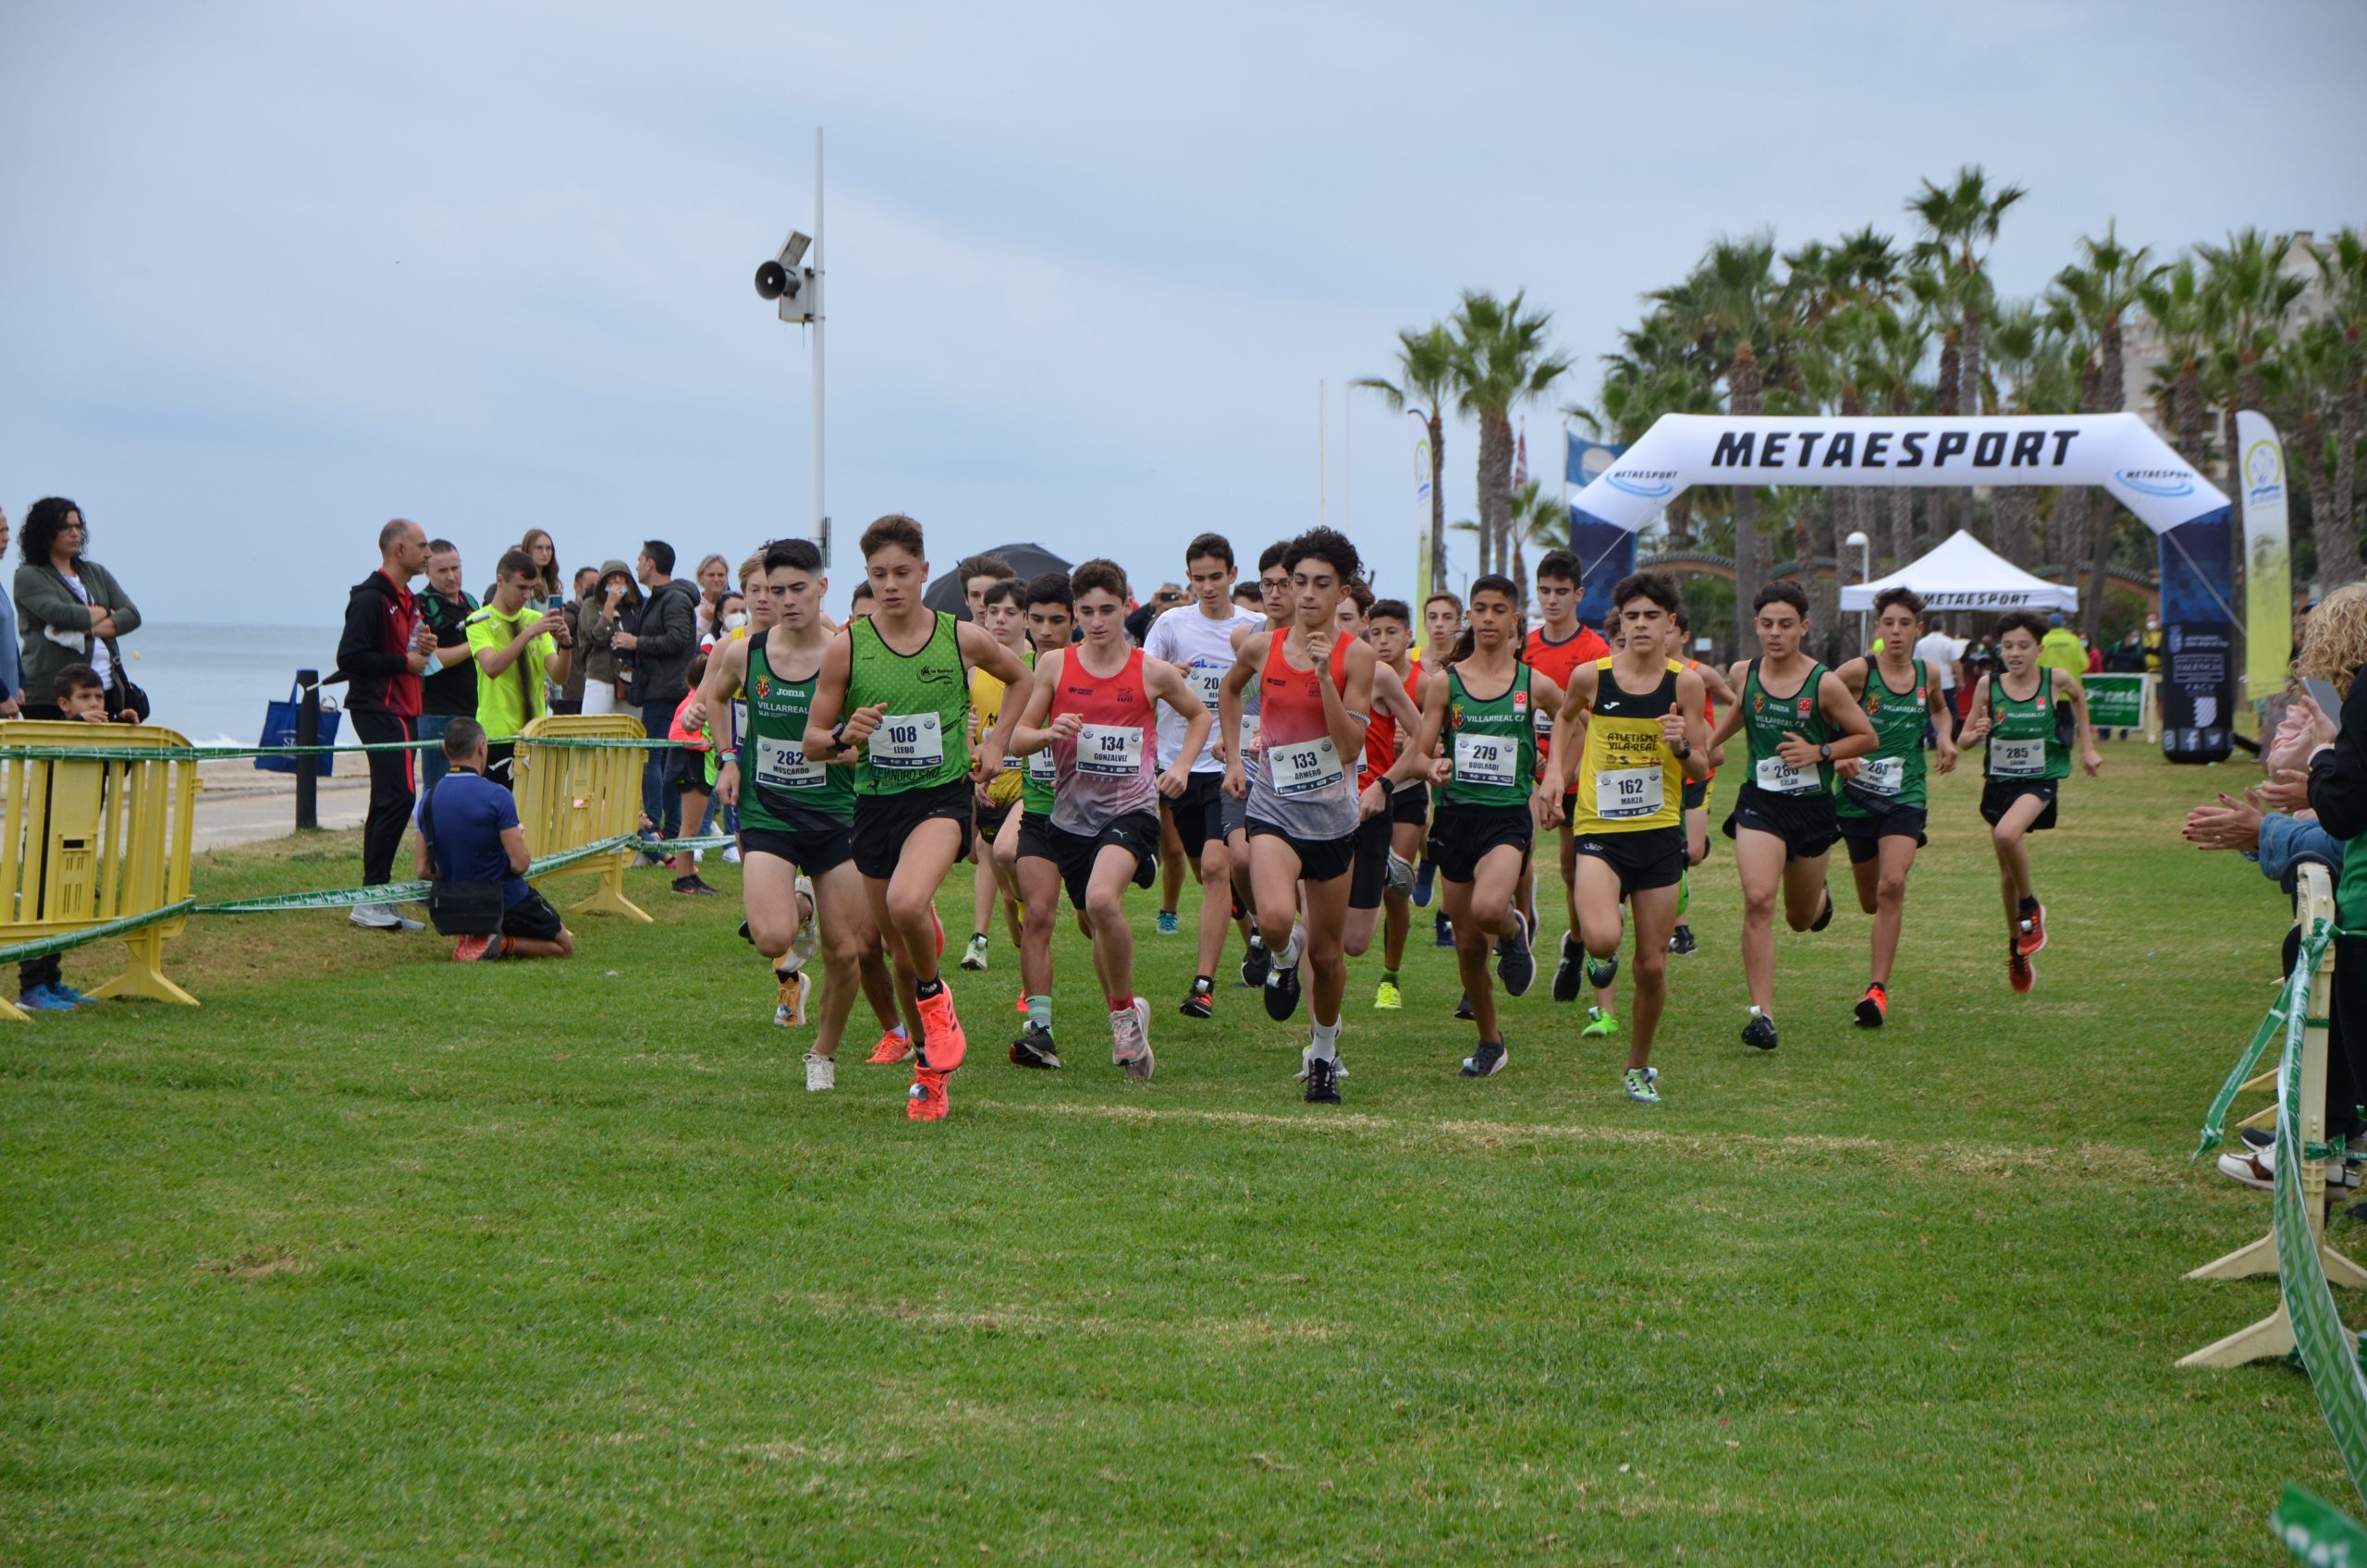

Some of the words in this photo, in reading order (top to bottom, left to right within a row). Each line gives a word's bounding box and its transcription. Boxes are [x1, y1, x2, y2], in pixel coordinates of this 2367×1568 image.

[1711, 429, 2080, 468] METAESPORT
[1613, 470, 1678, 480] METAESPORT
[2127, 469, 2193, 479] METAESPORT
[1924, 593, 2030, 606] METAESPORT
[777, 688, 805, 698] Joma
[757, 701, 809, 715] VILLARREAL
[1466, 715, 1514, 723] VILLARREAL
[889, 726, 917, 743] 108
[1607, 732, 1658, 742] ATLETISME
[893, 746, 914, 754] LLEDO
[1100, 736, 1124, 752] 134
[1609, 741, 1658, 753] VILA-REAL
[777, 750, 804, 766] 282
[1094, 753, 1128, 762] GONZALVEZ
[1473, 745, 1497, 761] 279
[2006, 747, 2029, 758] 285
[1291, 751, 1318, 769] 133
[773, 765, 810, 776] MOSCARDO
[1294, 767, 1321, 780] ARMERO
[1618, 778, 1644, 795] 162
[1621, 796, 1644, 805] MARZA
